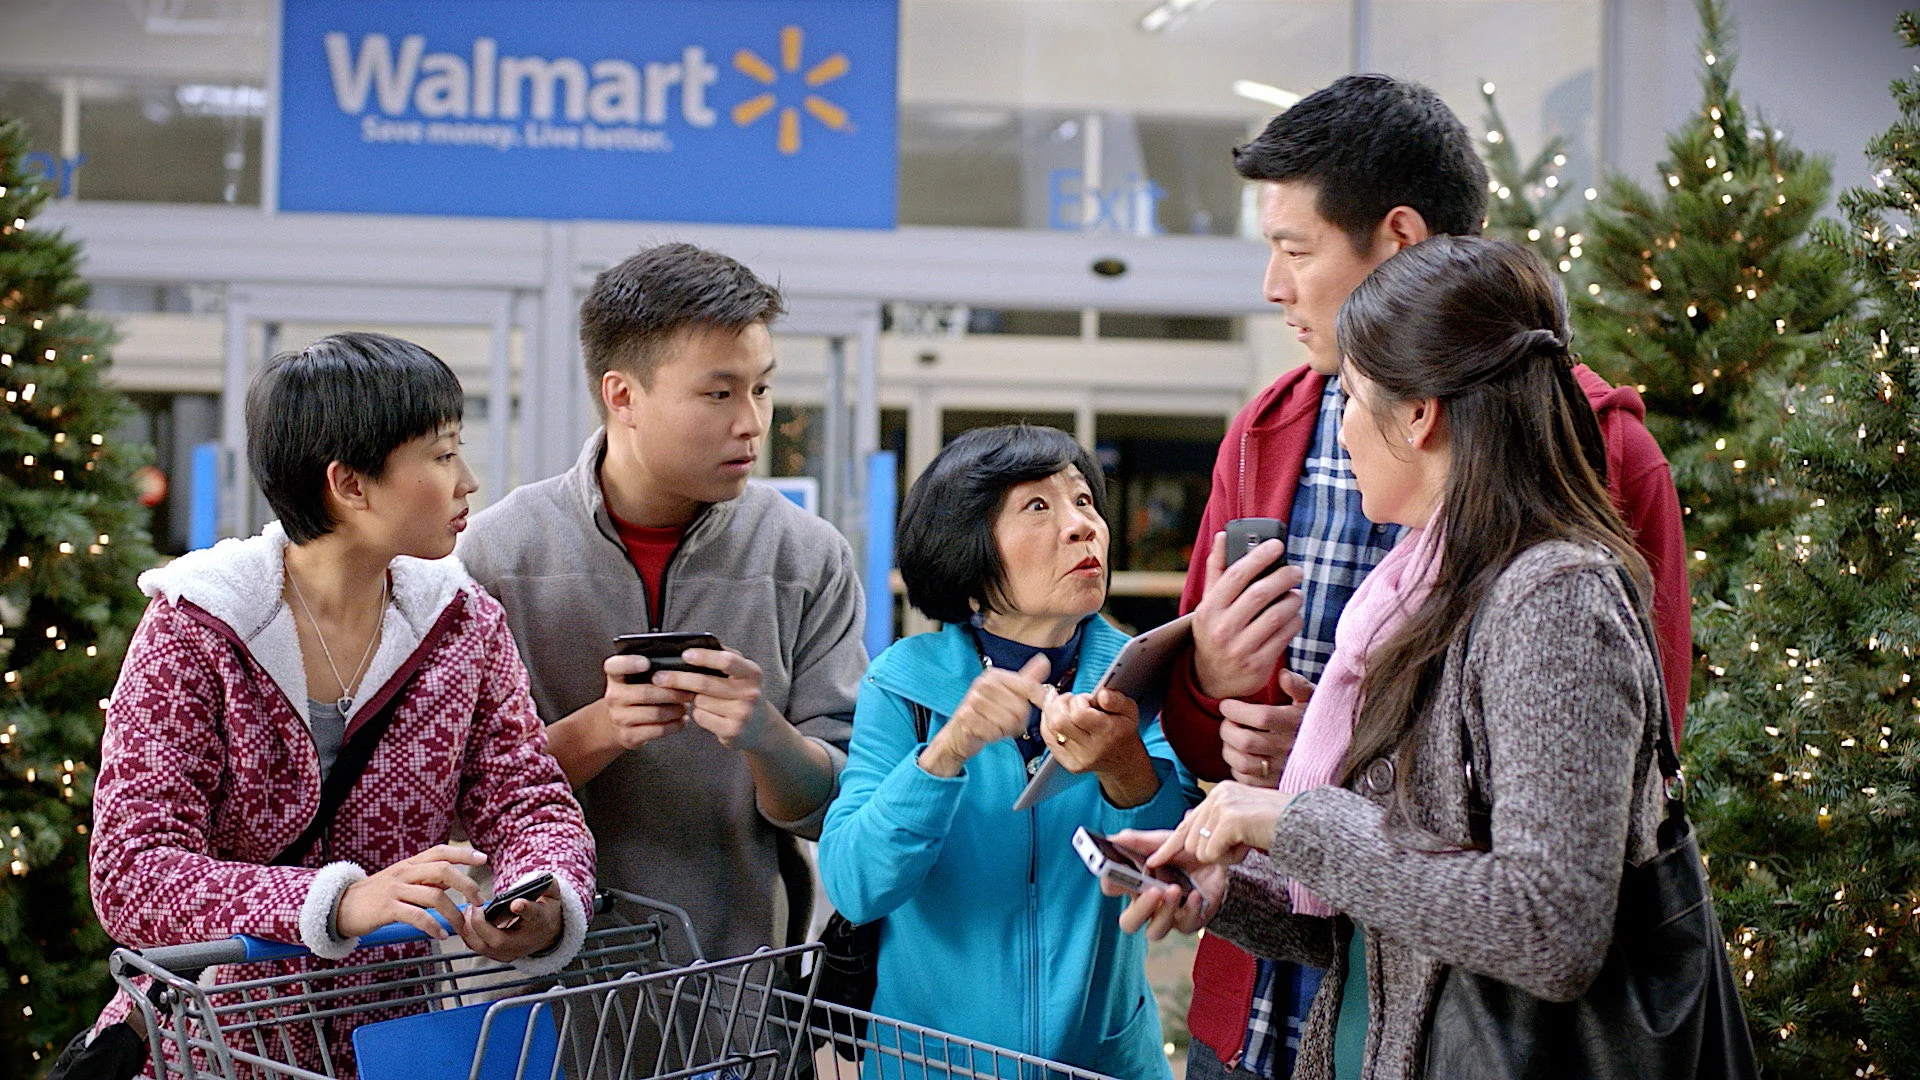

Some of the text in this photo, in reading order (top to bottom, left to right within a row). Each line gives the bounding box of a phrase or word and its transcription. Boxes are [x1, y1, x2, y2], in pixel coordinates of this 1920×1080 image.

[323, 31, 717, 128] Walmart
[361, 115, 674, 152] Save money. Live better.
[1048, 167, 1168, 234] Exit
